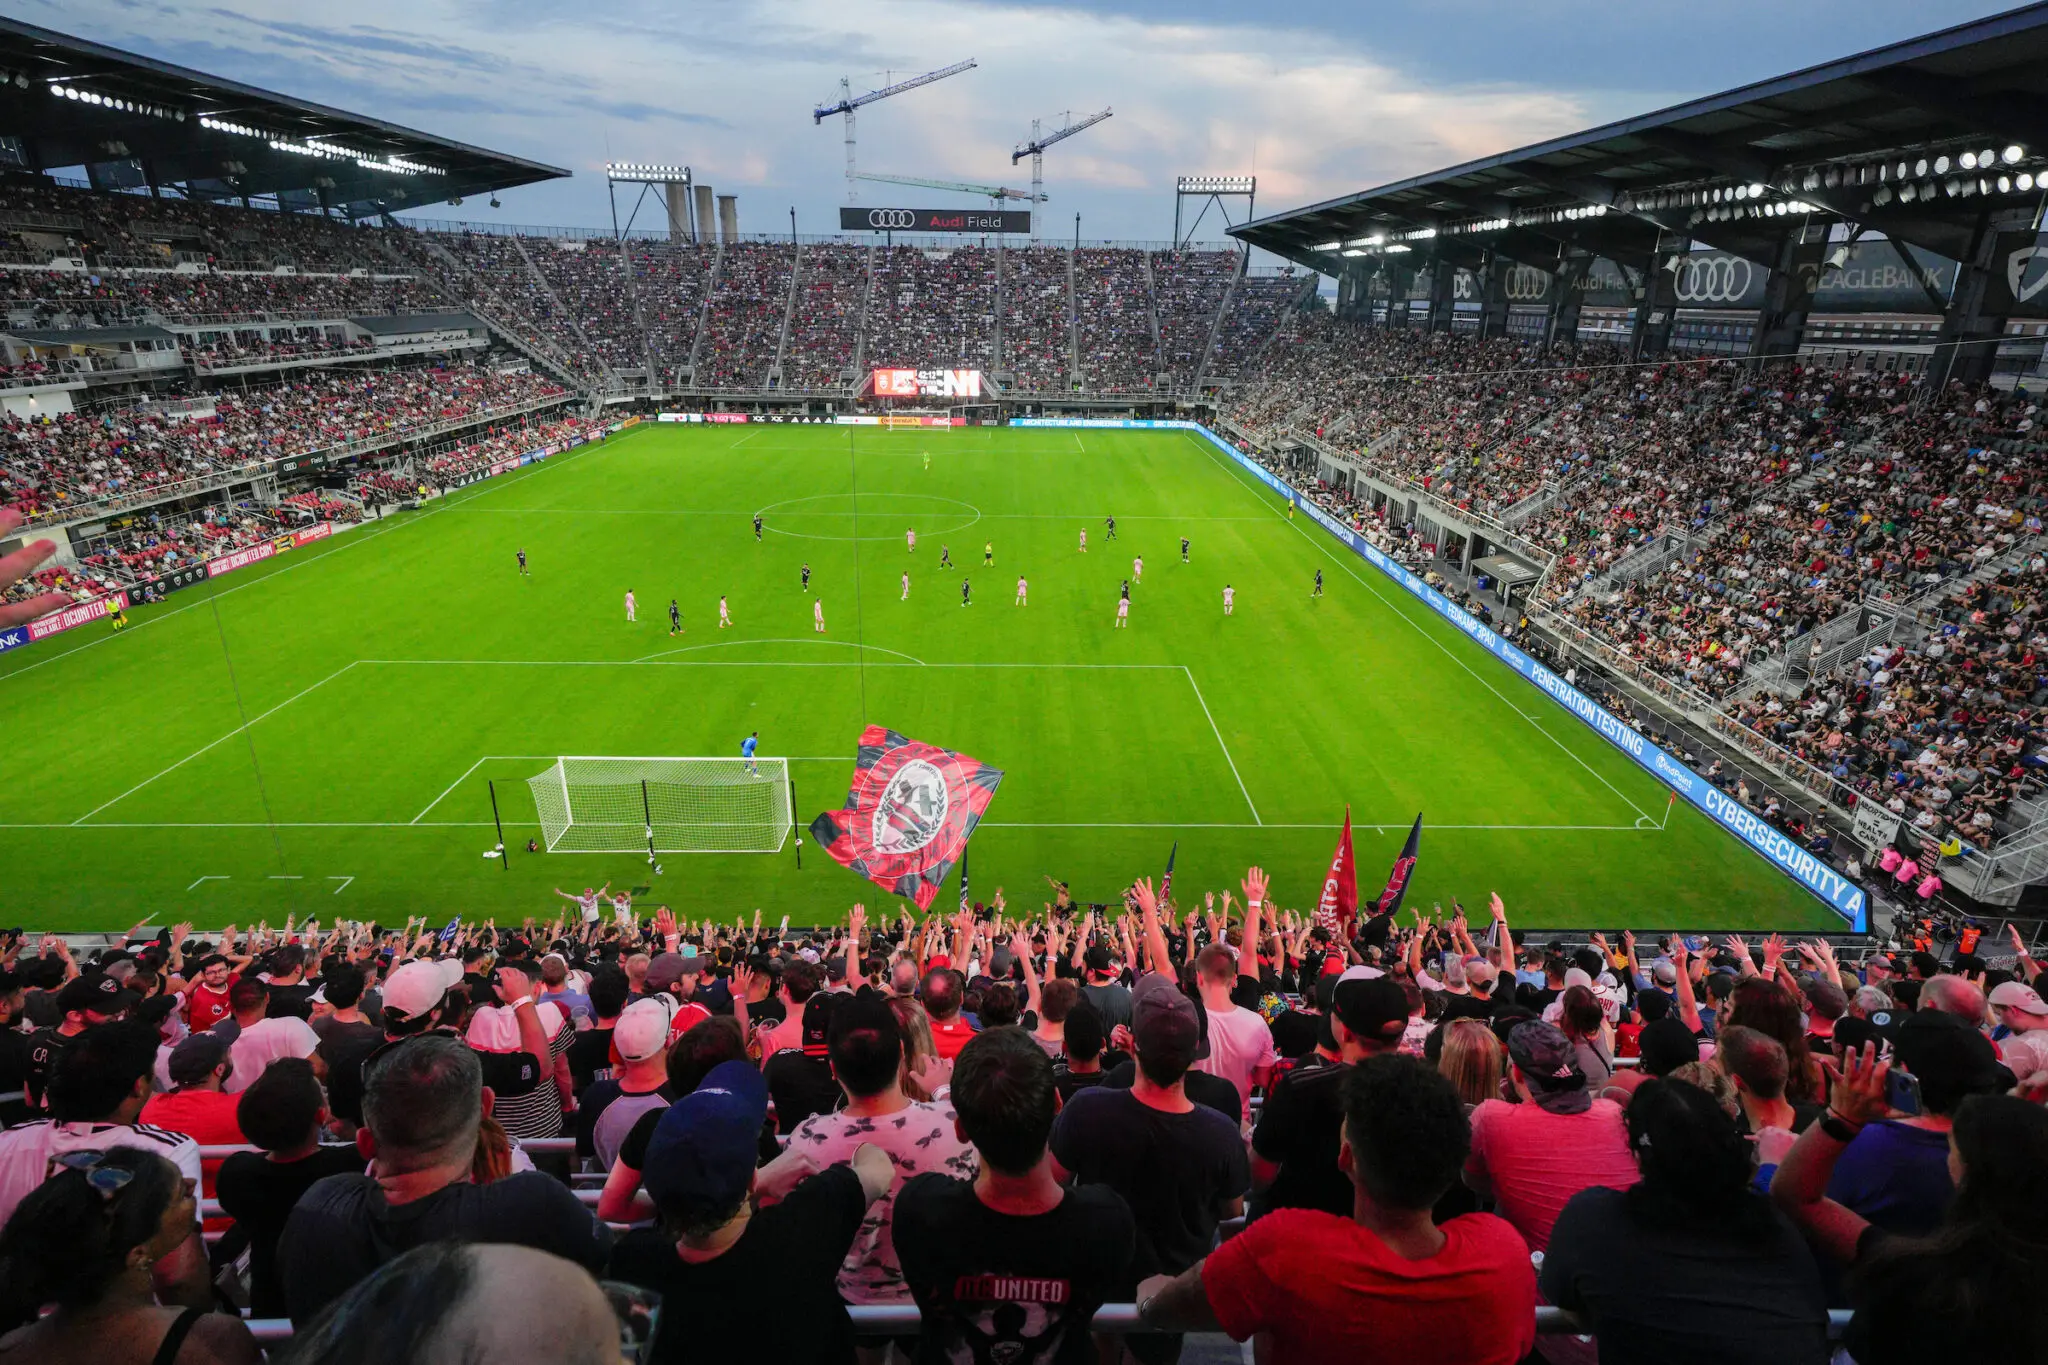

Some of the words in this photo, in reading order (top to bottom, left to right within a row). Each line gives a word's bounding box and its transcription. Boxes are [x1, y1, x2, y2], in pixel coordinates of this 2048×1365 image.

[930, 215, 965, 227] Audi
[968, 216, 1001, 228] Field
[1453, 274, 1471, 299] DC
[1571, 272, 1603, 290] Audi
[1606, 272, 1637, 290] Fied
[1022, 419, 1068, 427] ARCHITECTURE
[1083, 420, 1123, 428] ENGINEERING
[310, 456, 324, 465] Field
[63, 594, 125, 626] DCUNITED.M
[33, 621, 61, 638] AVAILABLE
[1447, 600, 1478, 634] FEDRAMP
[1478, 624, 1496, 648] 3PAO
[1532, 663, 1595, 721] PENETRATION
[1596, 708, 1643, 756] TESTING
[1858, 819, 1888, 840] HEALTH
[1858, 830, 1879, 846] CARE
[1705, 788, 1848, 901] CYBERSECURITY
[994, 1279, 1063, 1302] UNITED
